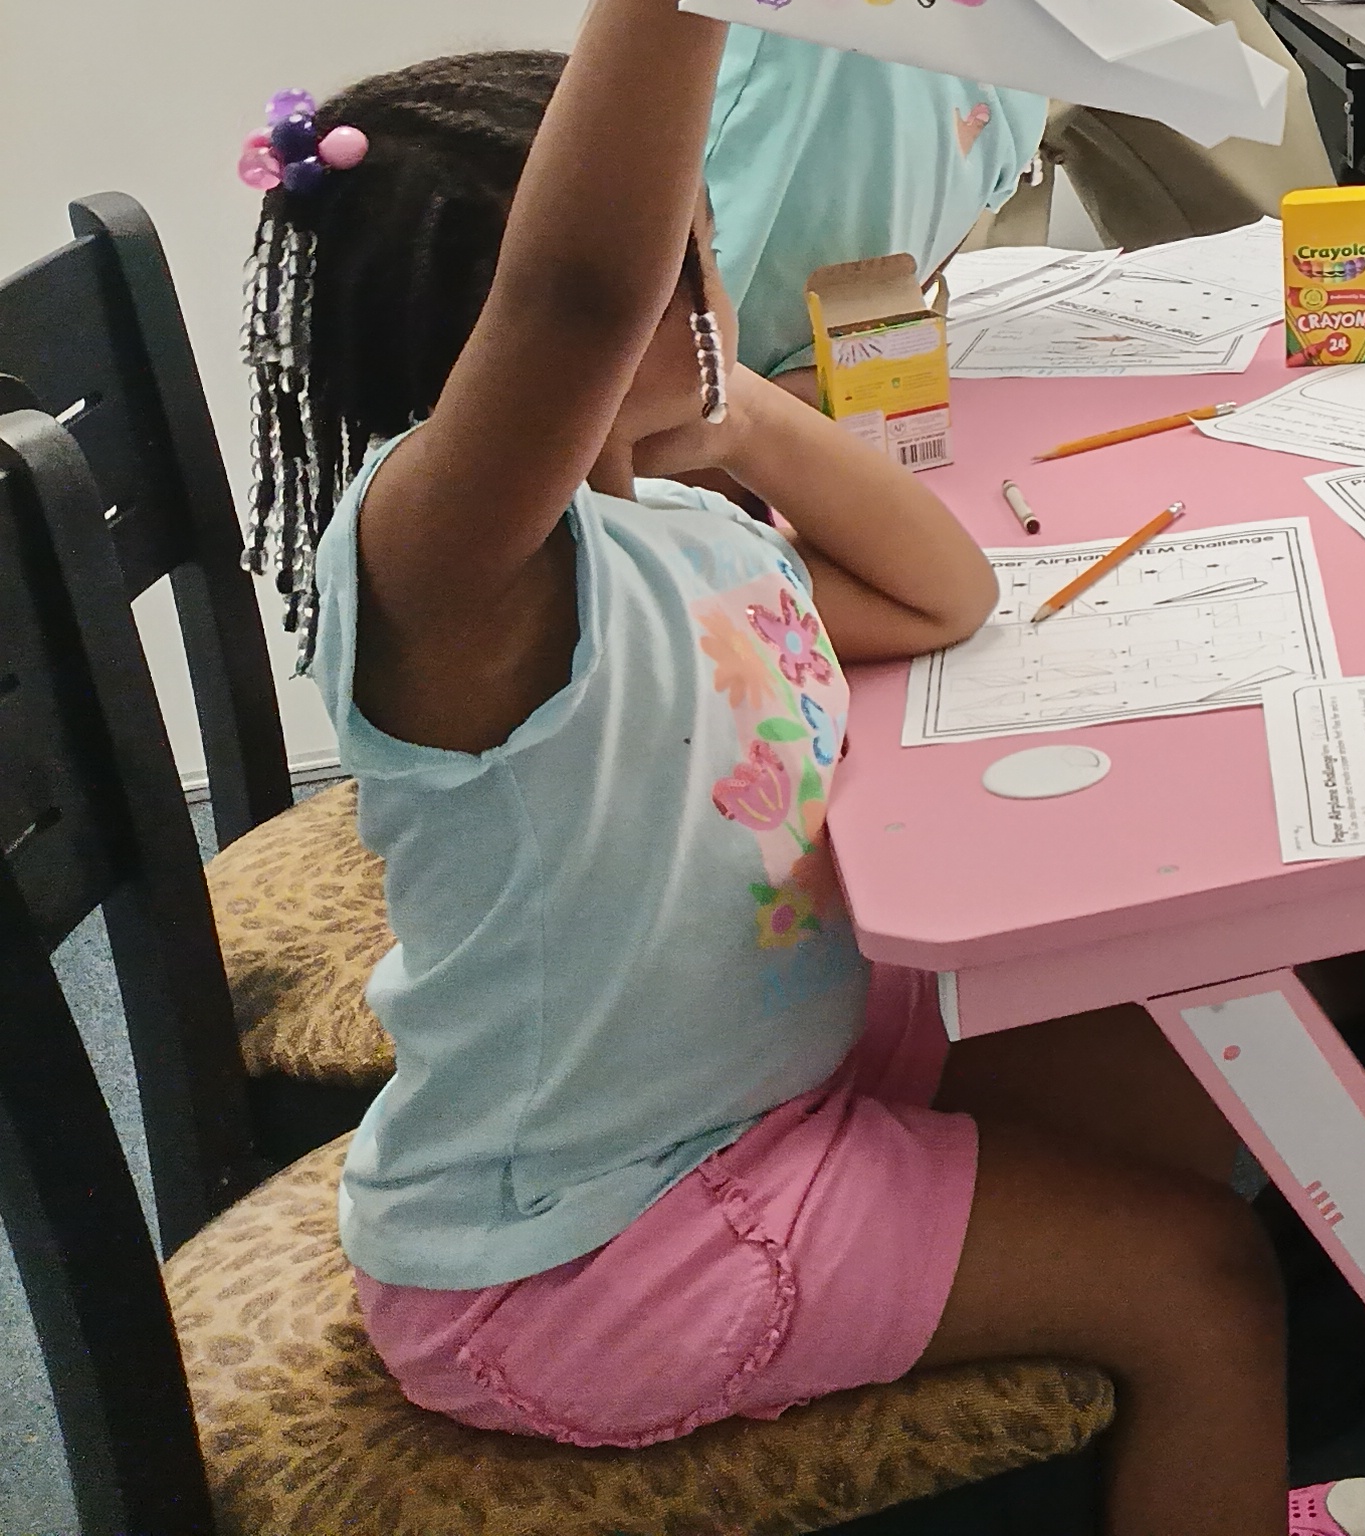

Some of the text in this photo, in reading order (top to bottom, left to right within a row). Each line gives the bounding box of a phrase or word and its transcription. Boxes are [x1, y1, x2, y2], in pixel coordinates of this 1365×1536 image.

[1329, 337, 1348, 352] 24
[1182, 534, 1274, 552] Challenge
[1320, 754, 1339, 787] Challenge
[1325, 788, 1345, 820] Airplane
[1329, 822, 1348, 843] Paper
